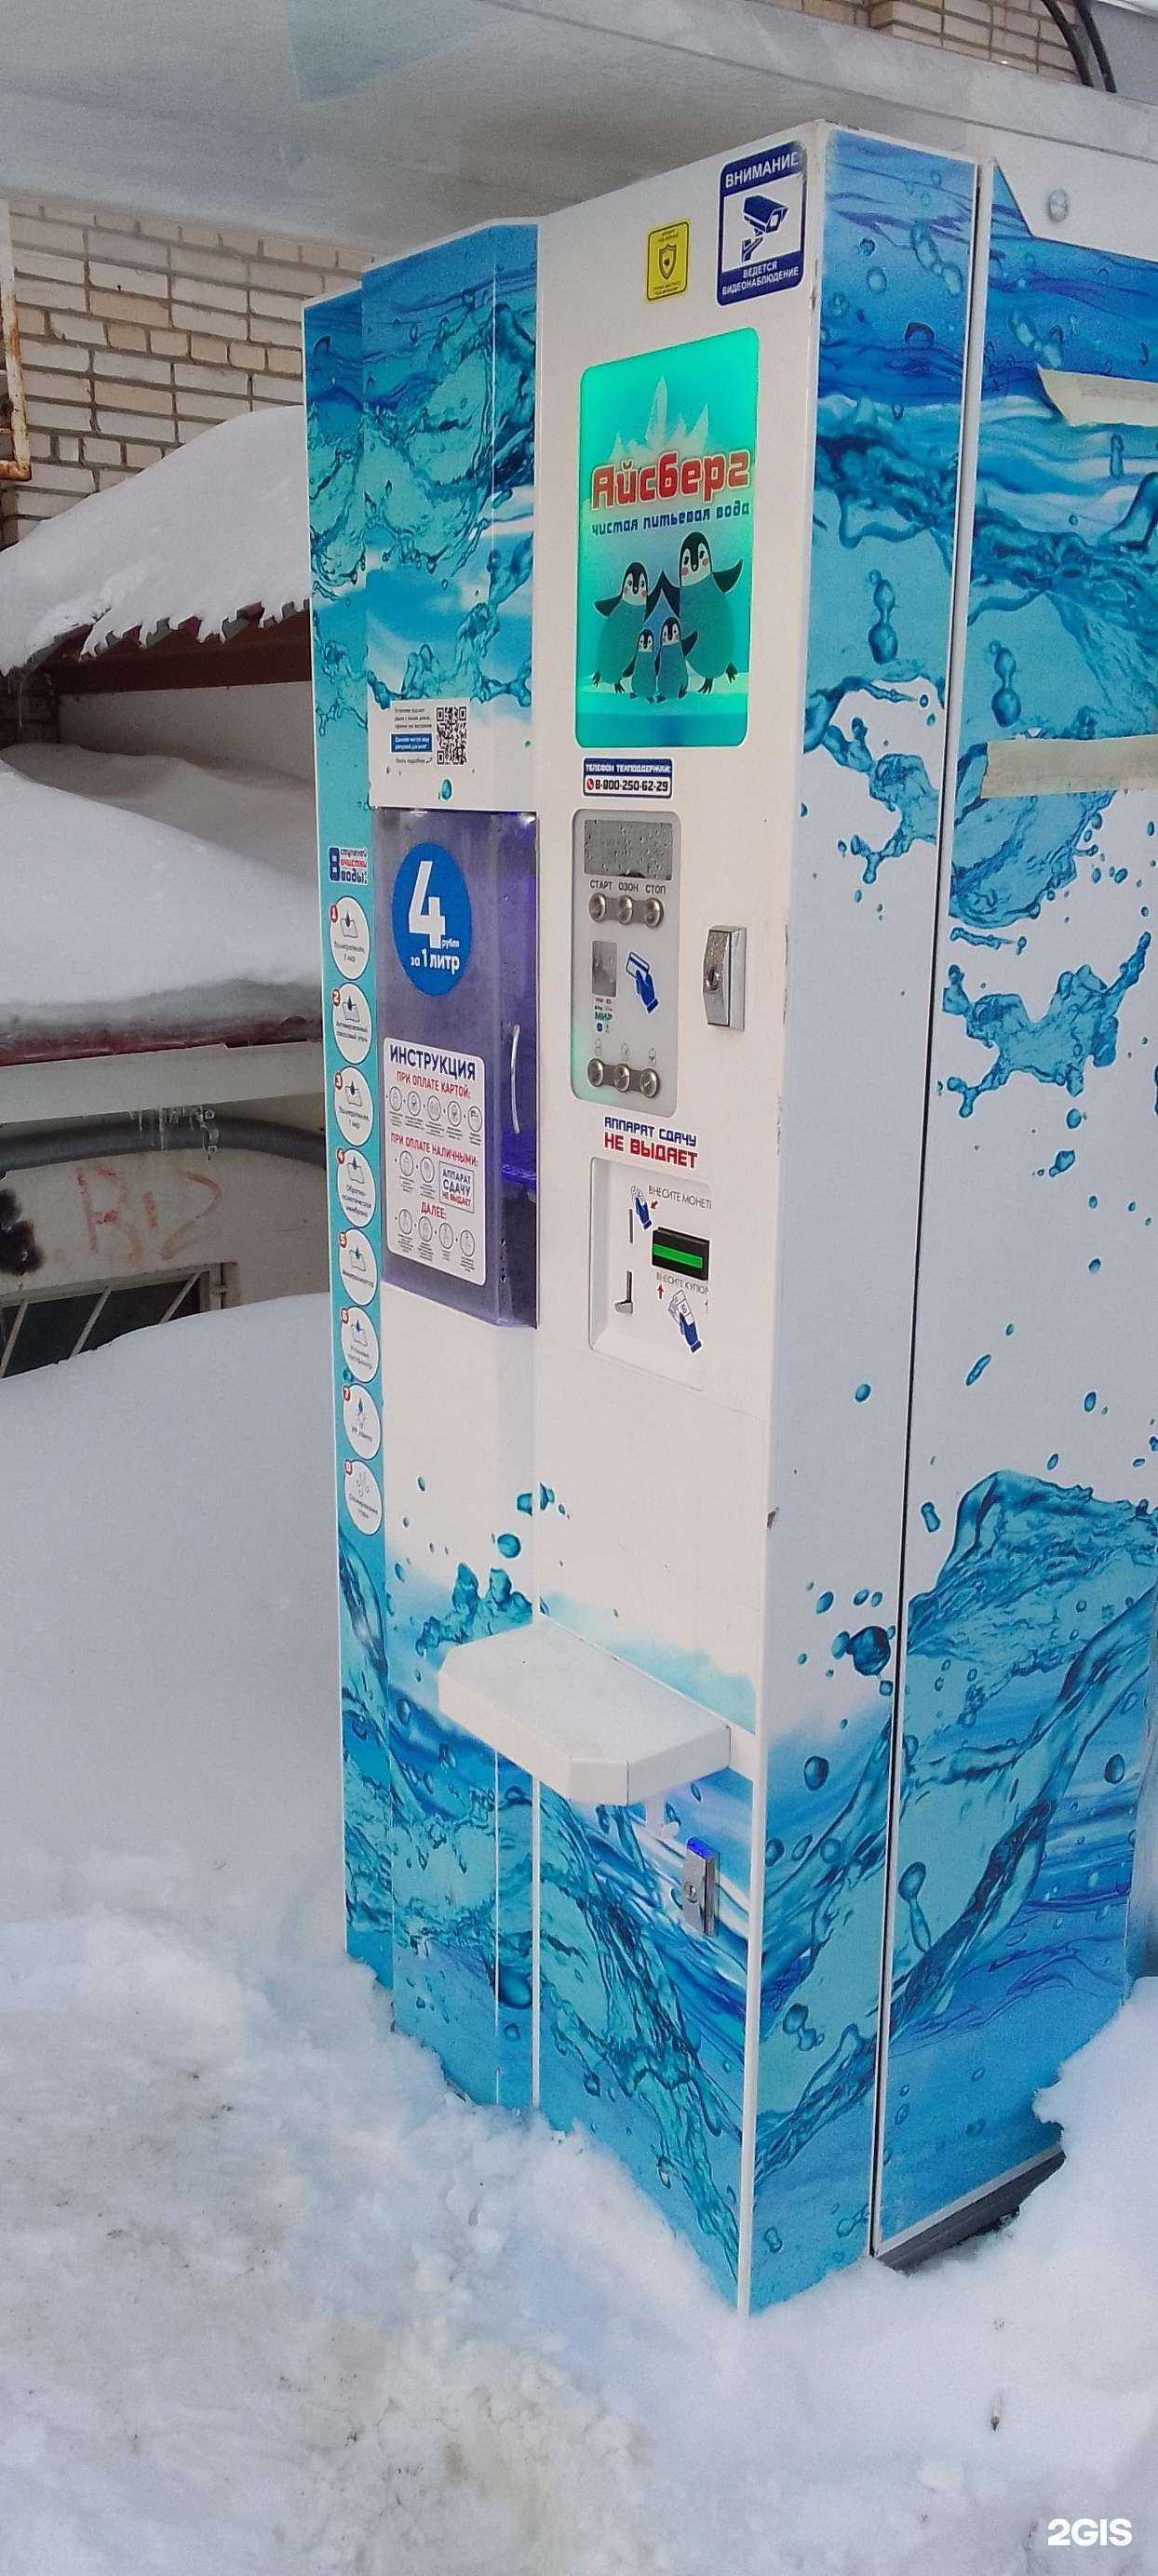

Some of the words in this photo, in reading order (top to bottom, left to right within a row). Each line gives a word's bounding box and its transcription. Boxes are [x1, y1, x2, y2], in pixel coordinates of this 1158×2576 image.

[724, 151, 801, 188] ВНИМАНИЕ
[721, 266, 800, 296] ВИДЕОНАБЛЮДЕНИЕ
[743, 261, 778, 277] ВЕДЕТСЯ
[591, 449, 751, 511] Айсберг
[592, 519, 639, 536] чистая
[642, 508, 710, 530] питьевая
[716, 500, 750, 518] вода
[595, 779, 669, 792] 8-800-250-62-29
[589, 879, 613, 891] СТАРТ
[618, 881, 640, 892] ОЗОН
[645, 884, 667, 895] СТОП
[409, 860, 446, 949] 4
[421, 947, 428, 968] 1
[429, 954, 460, 975] литр
[389, 1043, 477, 1081] ИНСТРУКЦИЯ
[397, 1070, 411, 1084] ПРИ
[411, 1074, 440, 1093] ОПЛАТЕ
[390, 1132, 404, 1147] ПРИ
[405, 1135, 431, 1154] ОПЛАТЕ
[604, 1116, 655, 1138] АППАРАТ
[658, 1128, 697, 1147] СДАЧУ
[604, 1132, 625, 1152] НЕ
[629, 1137, 698, 1169] ВЫДАЕТ
[442, 1168, 472, 1185] АППАРАТ
[442, 1178, 471, 1198] СДАЧУ
[420, 1201, 447, 1220] ДАЛЕЕ:
